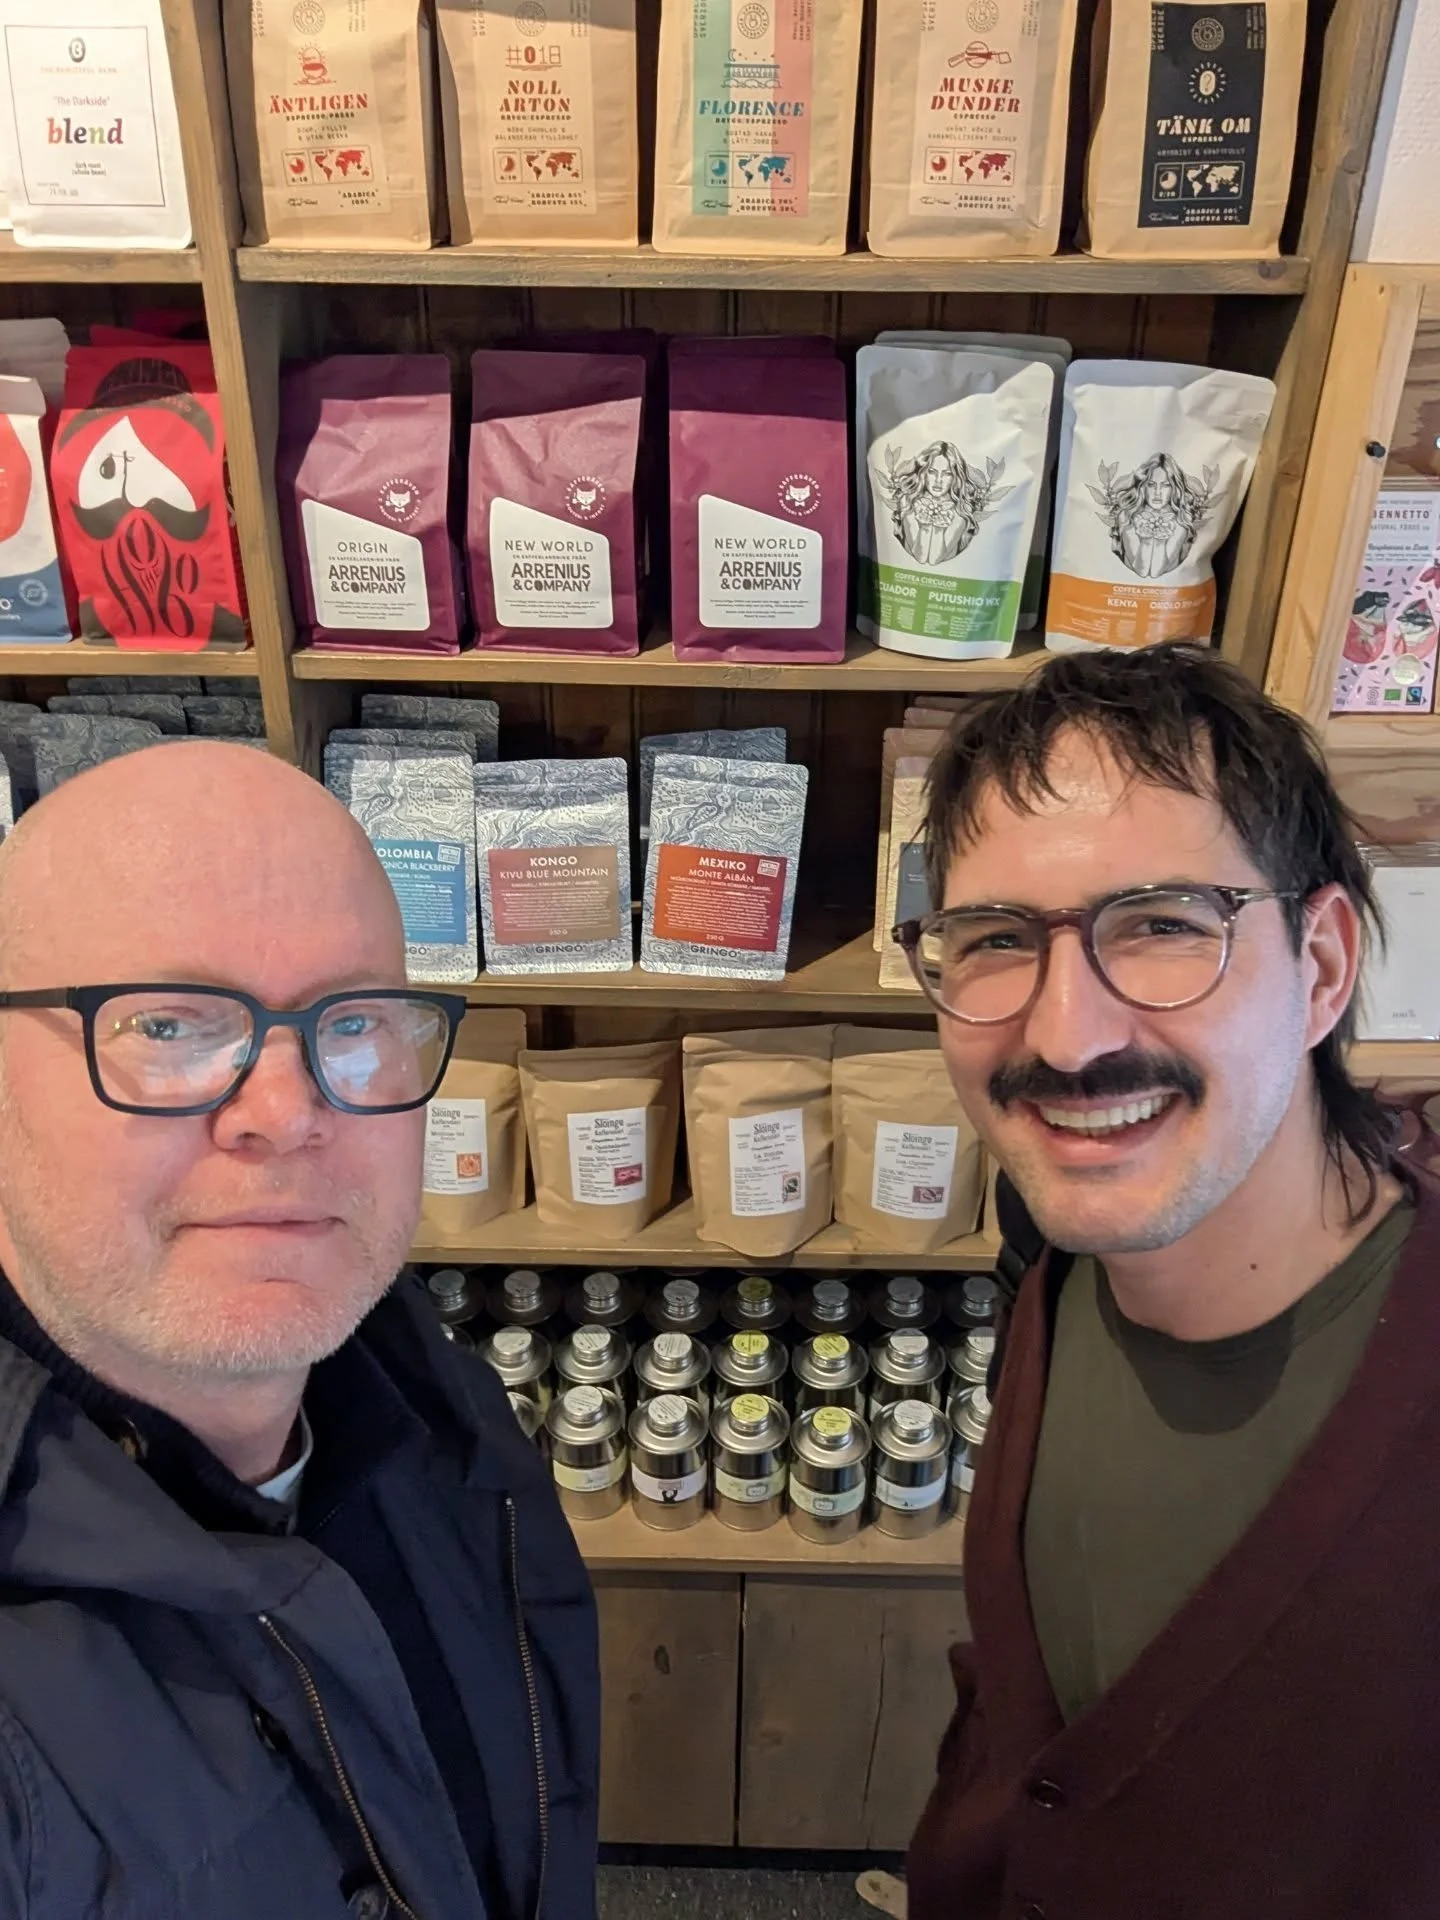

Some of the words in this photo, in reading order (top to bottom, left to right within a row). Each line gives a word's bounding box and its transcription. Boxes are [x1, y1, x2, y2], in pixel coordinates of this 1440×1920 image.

[508, 80, 562, 95] NOLL
[939, 77, 1014, 95] MUSKE
[269, 93, 368, 114] ÄNTLIGEN
[499, 97, 571, 113] ARTON
[699, 100, 805, 117] FLORENCE
[930, 95, 1021, 113] DUNDER
[47, 117, 124, 145] blend
[1156, 115, 1213, 136] TÄNK
[1221, 117, 1251, 134] OM
[337, 541, 388, 553] ORIGIN
[504, 540, 535, 551] NEW
[541, 541, 594, 553] WORLD
[714, 538, 747, 549] NEW
[752, 538, 807, 550] WORLD
[328, 564, 406, 582] ARRENIUS
[511, 562, 591, 579] ARRENIUS
[719, 561, 802, 577] ARRENIUS
[894, 572, 920, 583] COFFEA
[1112, 585, 1142, 595] COFFEA
[928, 591, 983, 606] PUTUSHIO
[1107, 598, 1138, 609] KENYA
[375, 848, 434, 860] OLOMBIA
[529, 856, 578, 867] KONGO
[410, 861, 456, 872] BLACKBERRY
[698, 856, 747, 871] MEXIKO
[499, 871, 523, 880] KIVU
[526, 870, 549, 879] BLUE
[552, 867, 609, 878] MOUNTAIN
[688, 868, 722, 880] MONTE
[723, 871, 755, 883] ALBÁN
[535, 945, 583, 954] GRINGO
[690, 945, 738, 958] GRINGO
